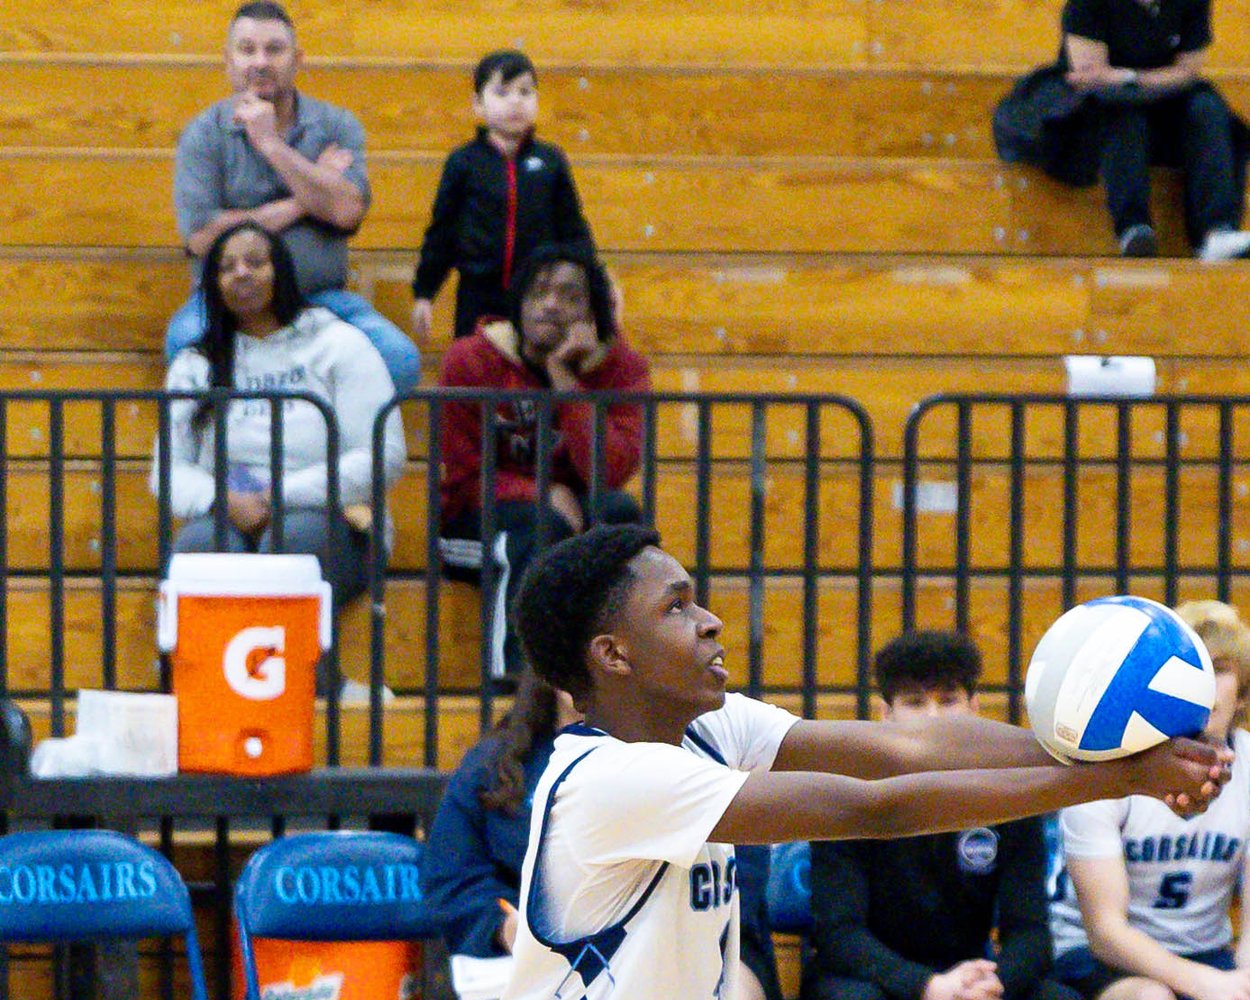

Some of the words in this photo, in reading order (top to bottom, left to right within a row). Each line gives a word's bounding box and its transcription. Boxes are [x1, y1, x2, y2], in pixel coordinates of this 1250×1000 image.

[222, 625, 286, 701] G
[0, 860, 157, 904] CORSAIRS
[275, 864, 424, 905] CORSAIR
[1152, 870, 1193, 909] 5
